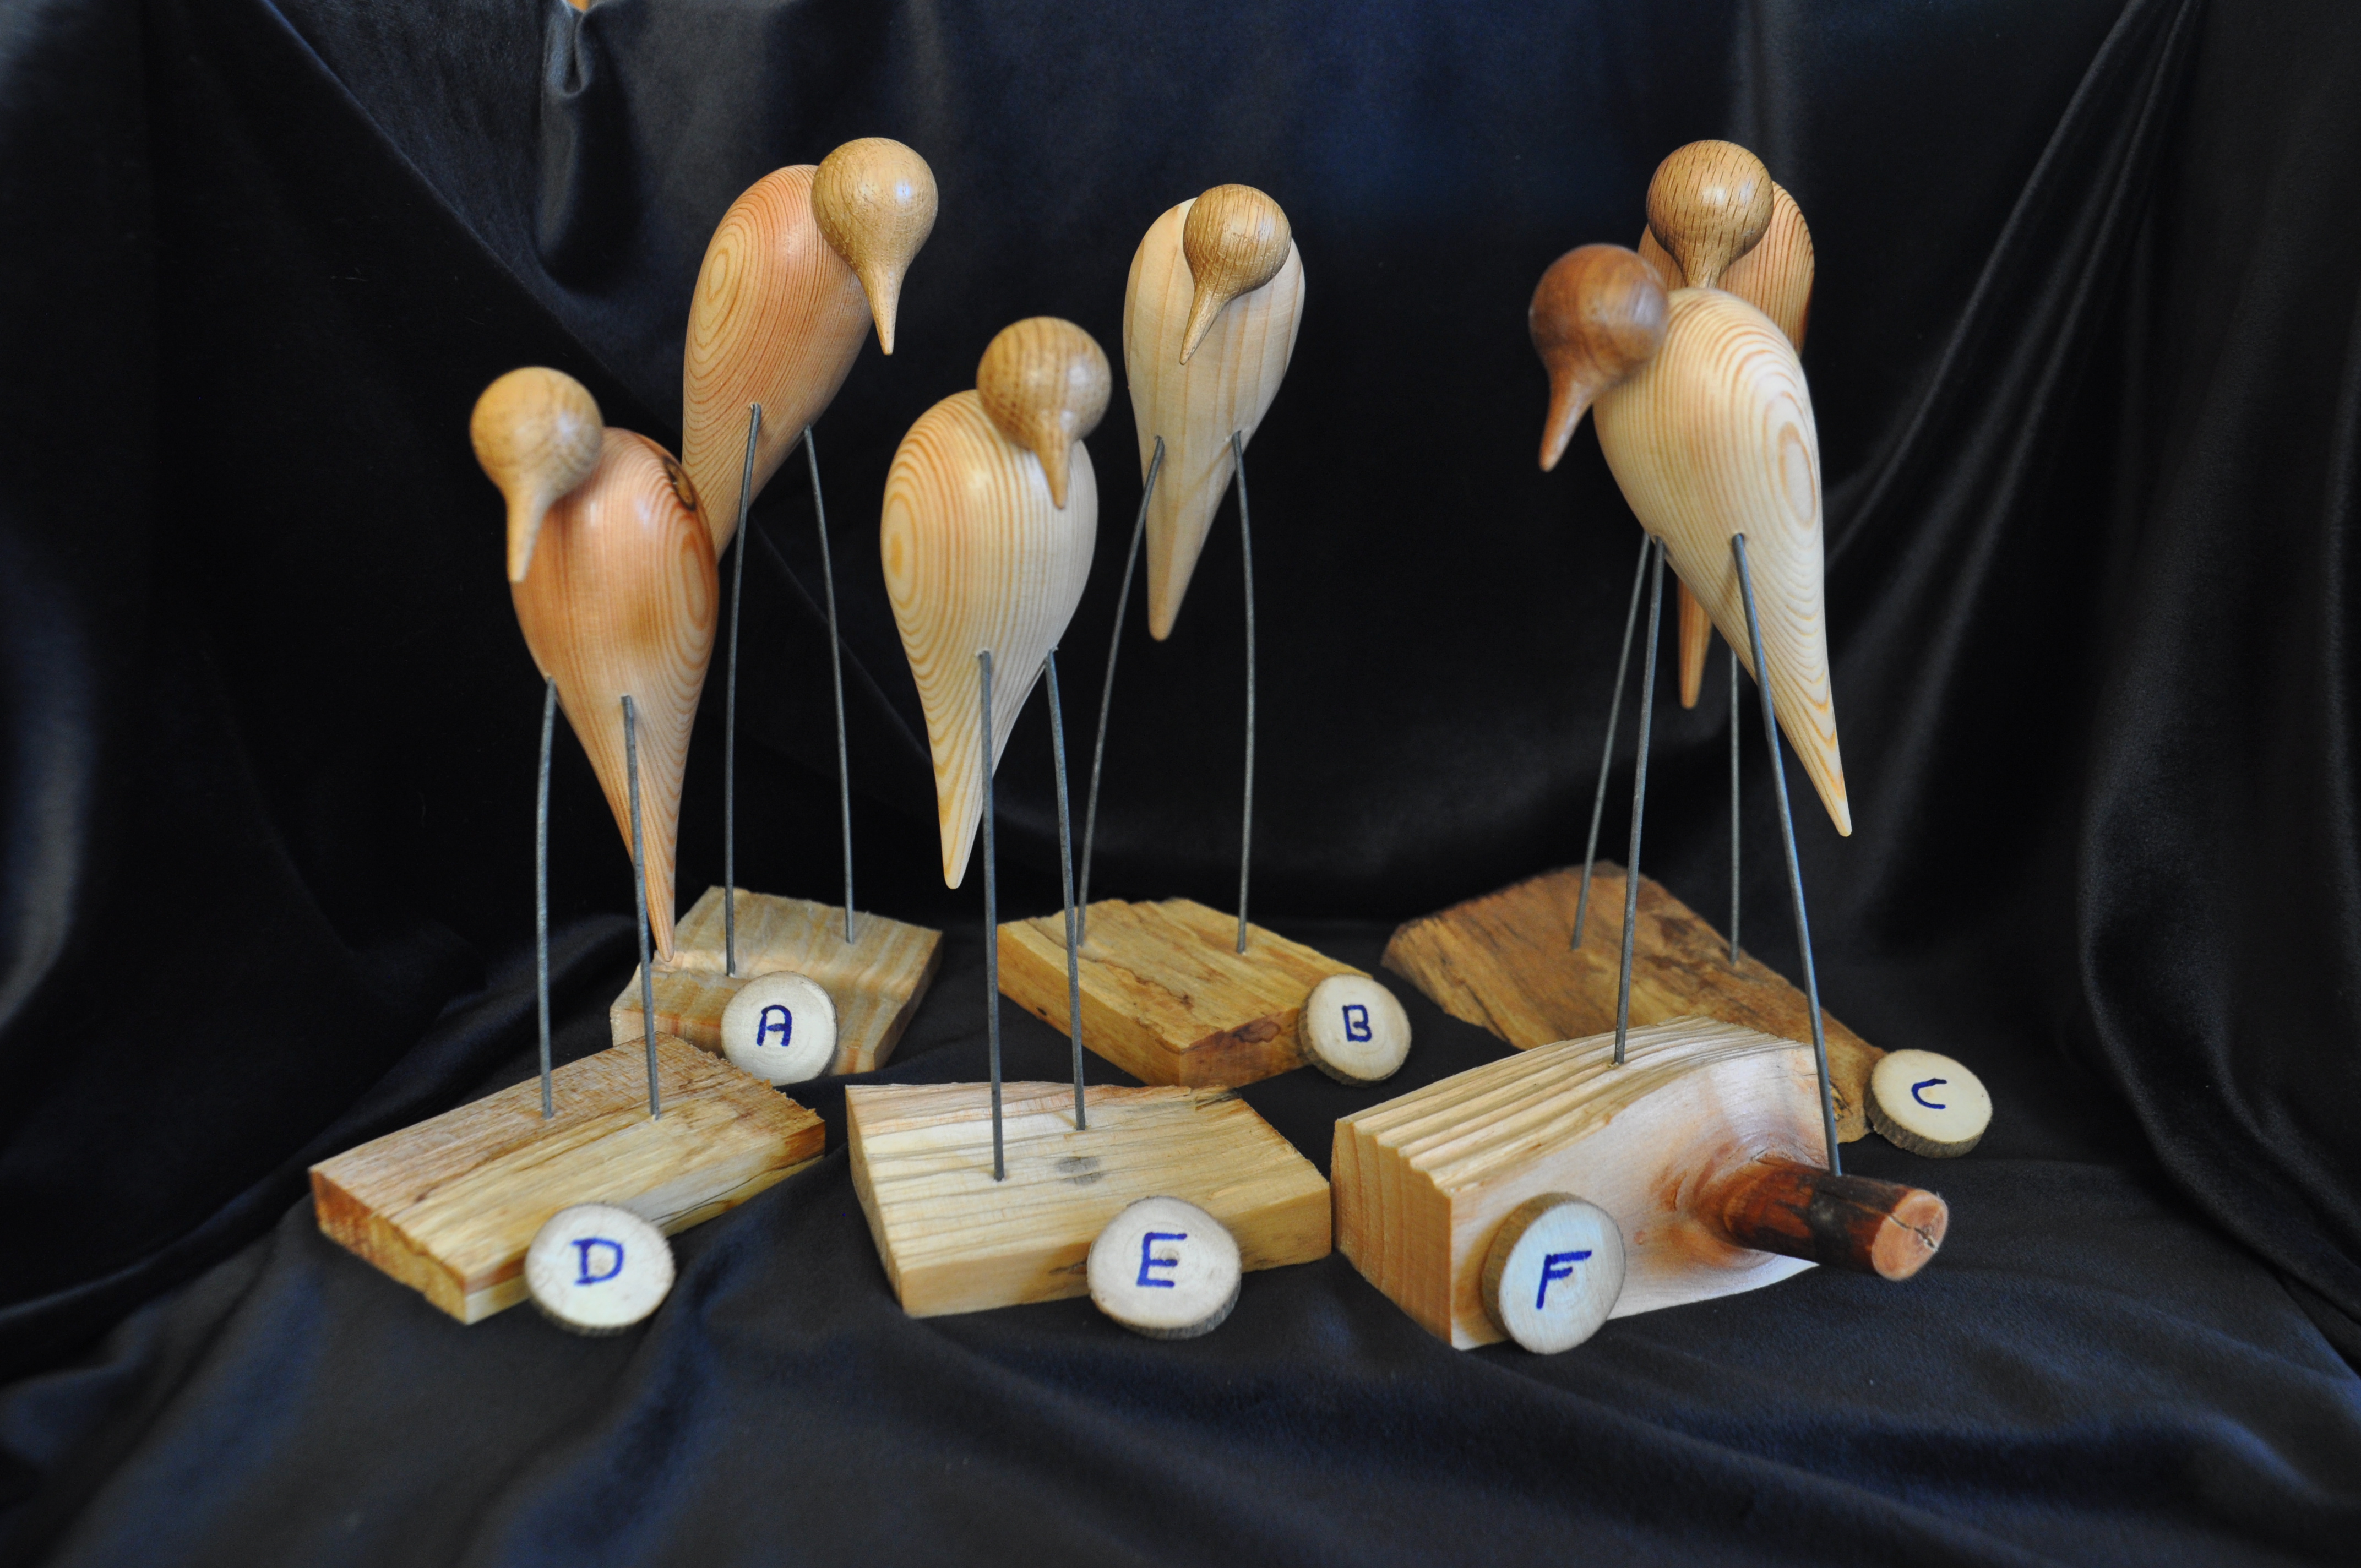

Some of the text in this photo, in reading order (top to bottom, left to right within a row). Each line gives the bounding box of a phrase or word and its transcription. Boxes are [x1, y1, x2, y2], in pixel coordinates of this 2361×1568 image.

[755, 1005, 793, 1048] A
[1342, 1005, 1372, 1042] B
[1911, 1079, 1947, 1109] C
[570, 1237, 624, 1284] D
[1135, 1232, 1188, 1289] E
[1536, 1250, 1592, 1310] F
